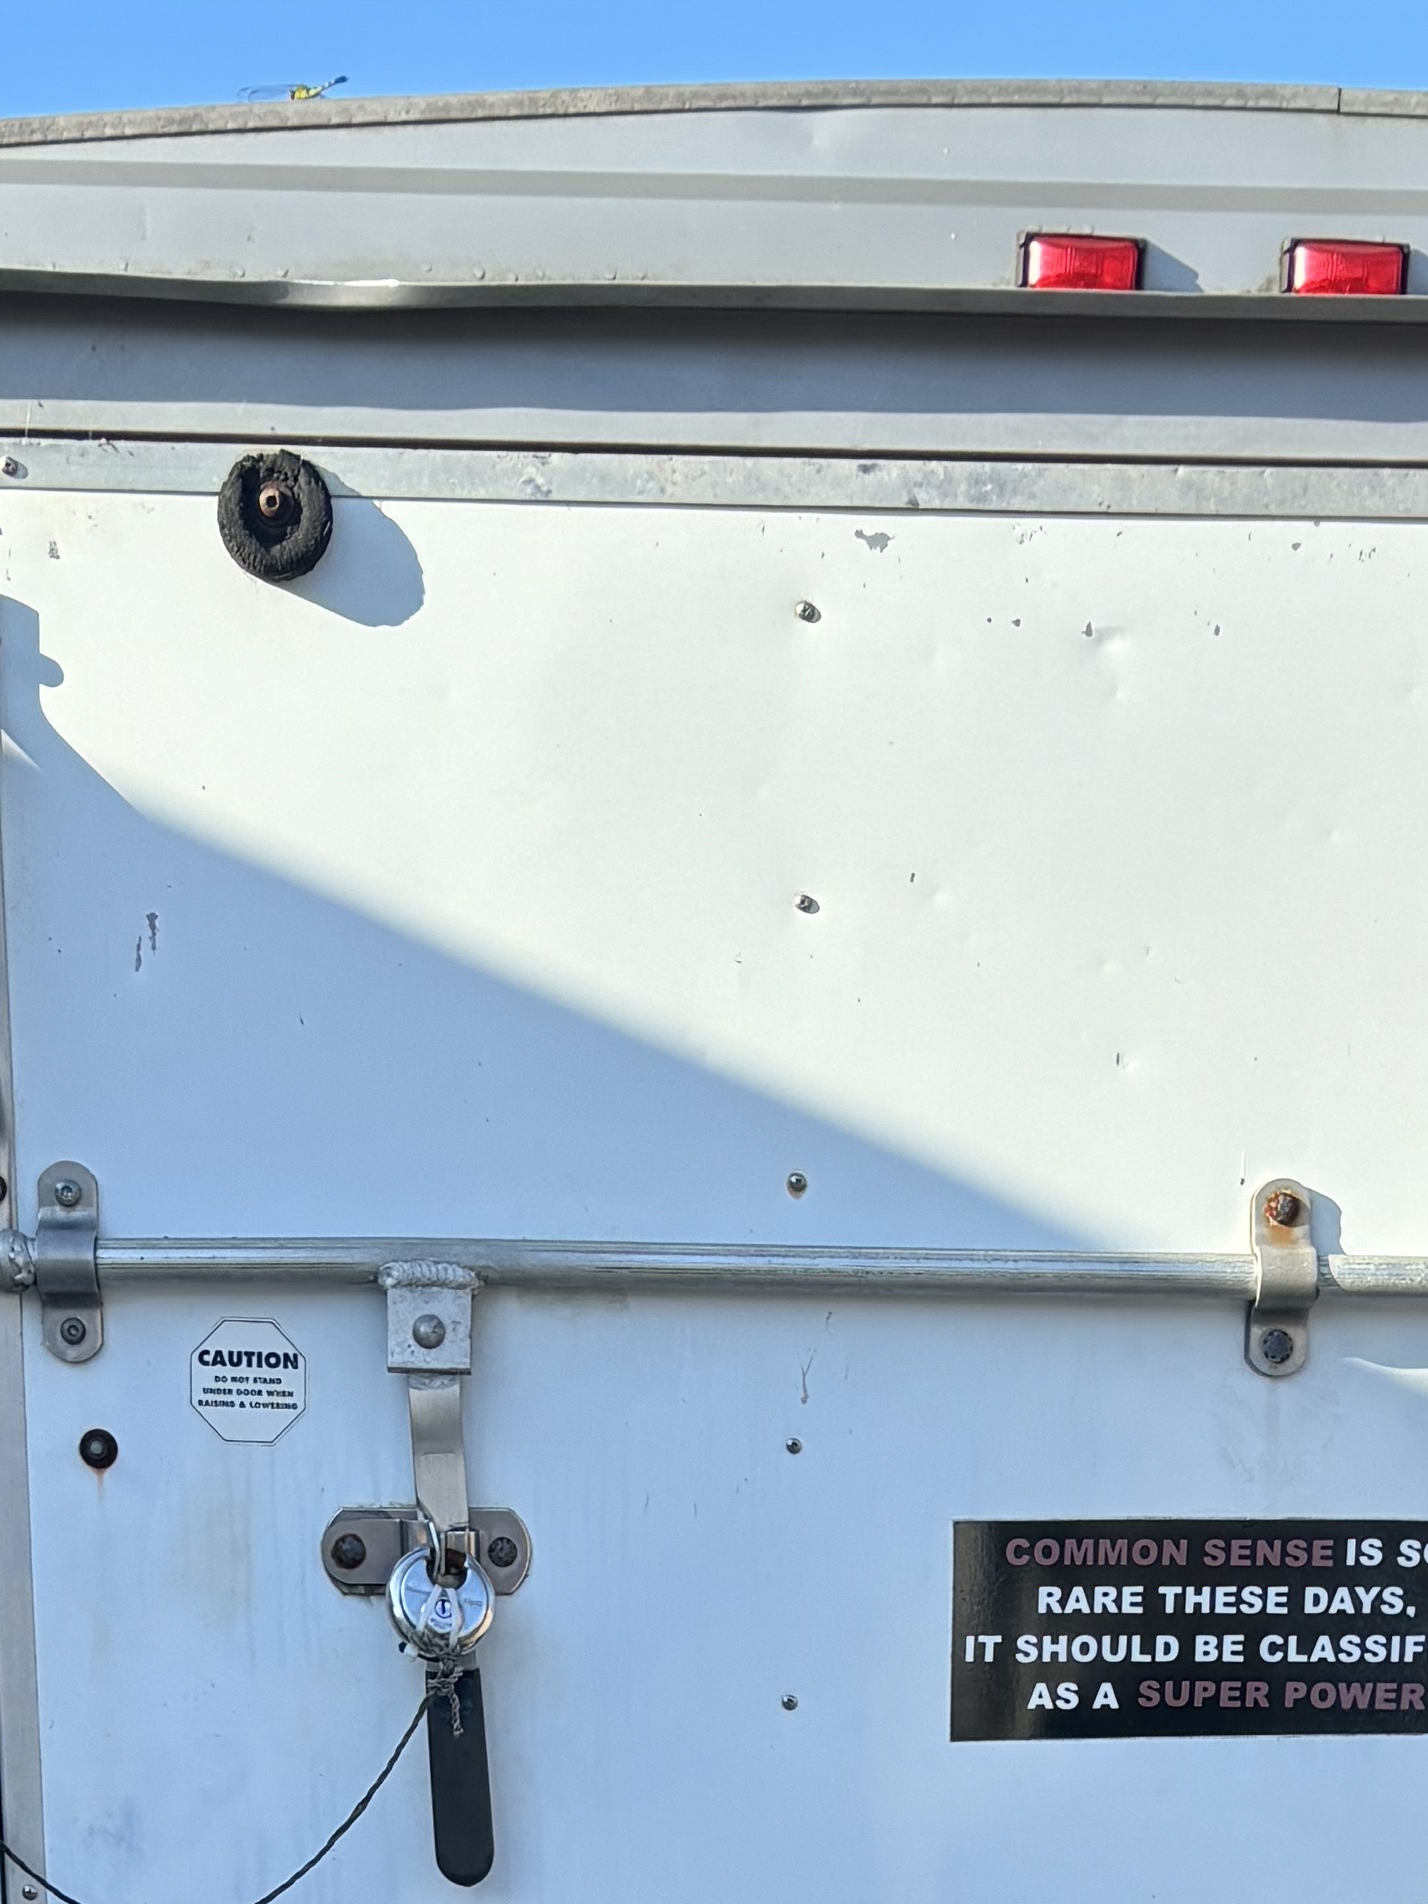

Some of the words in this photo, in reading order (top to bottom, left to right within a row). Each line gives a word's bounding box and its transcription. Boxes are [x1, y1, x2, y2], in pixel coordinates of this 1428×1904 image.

[197, 1349, 299, 1370] CAUTION
[202, 1387, 234, 1396] UNDER
[236, 1388, 263, 1397] DOOR
[266, 1389, 294, 1398] WHEN
[214, 1375, 228, 1384] DO
[230, 1376, 250, 1384] NOT
[253, 1377, 282, 1385] STAND
[198, 1399, 236, 1408] RAISING
[249, 1401, 298, 1410] LOWERING
[1005, 1538, 1188, 1567] COMMON
[1203, 1539, 1334, 1567] SENSE
[1346, 1539, 1383, 1567] IS
[1037, 1586, 1144, 1614] RARE
[1158, 1586, 1289, 1614] THESE
[1303, 1586, 1416, 1618] DAYS,
[964, 1635, 1002, 1663] IT
[1014, 1635, 1179, 1664] SHOULD
[1194, 1635, 1245, 1663] BE
[1027, 1682, 1079, 1710] AS
[1092, 1682, 1119, 1710] A
[1137, 1681, 1269, 1709] SUPER
[1284, 1681, 1426, 1711] POWER
